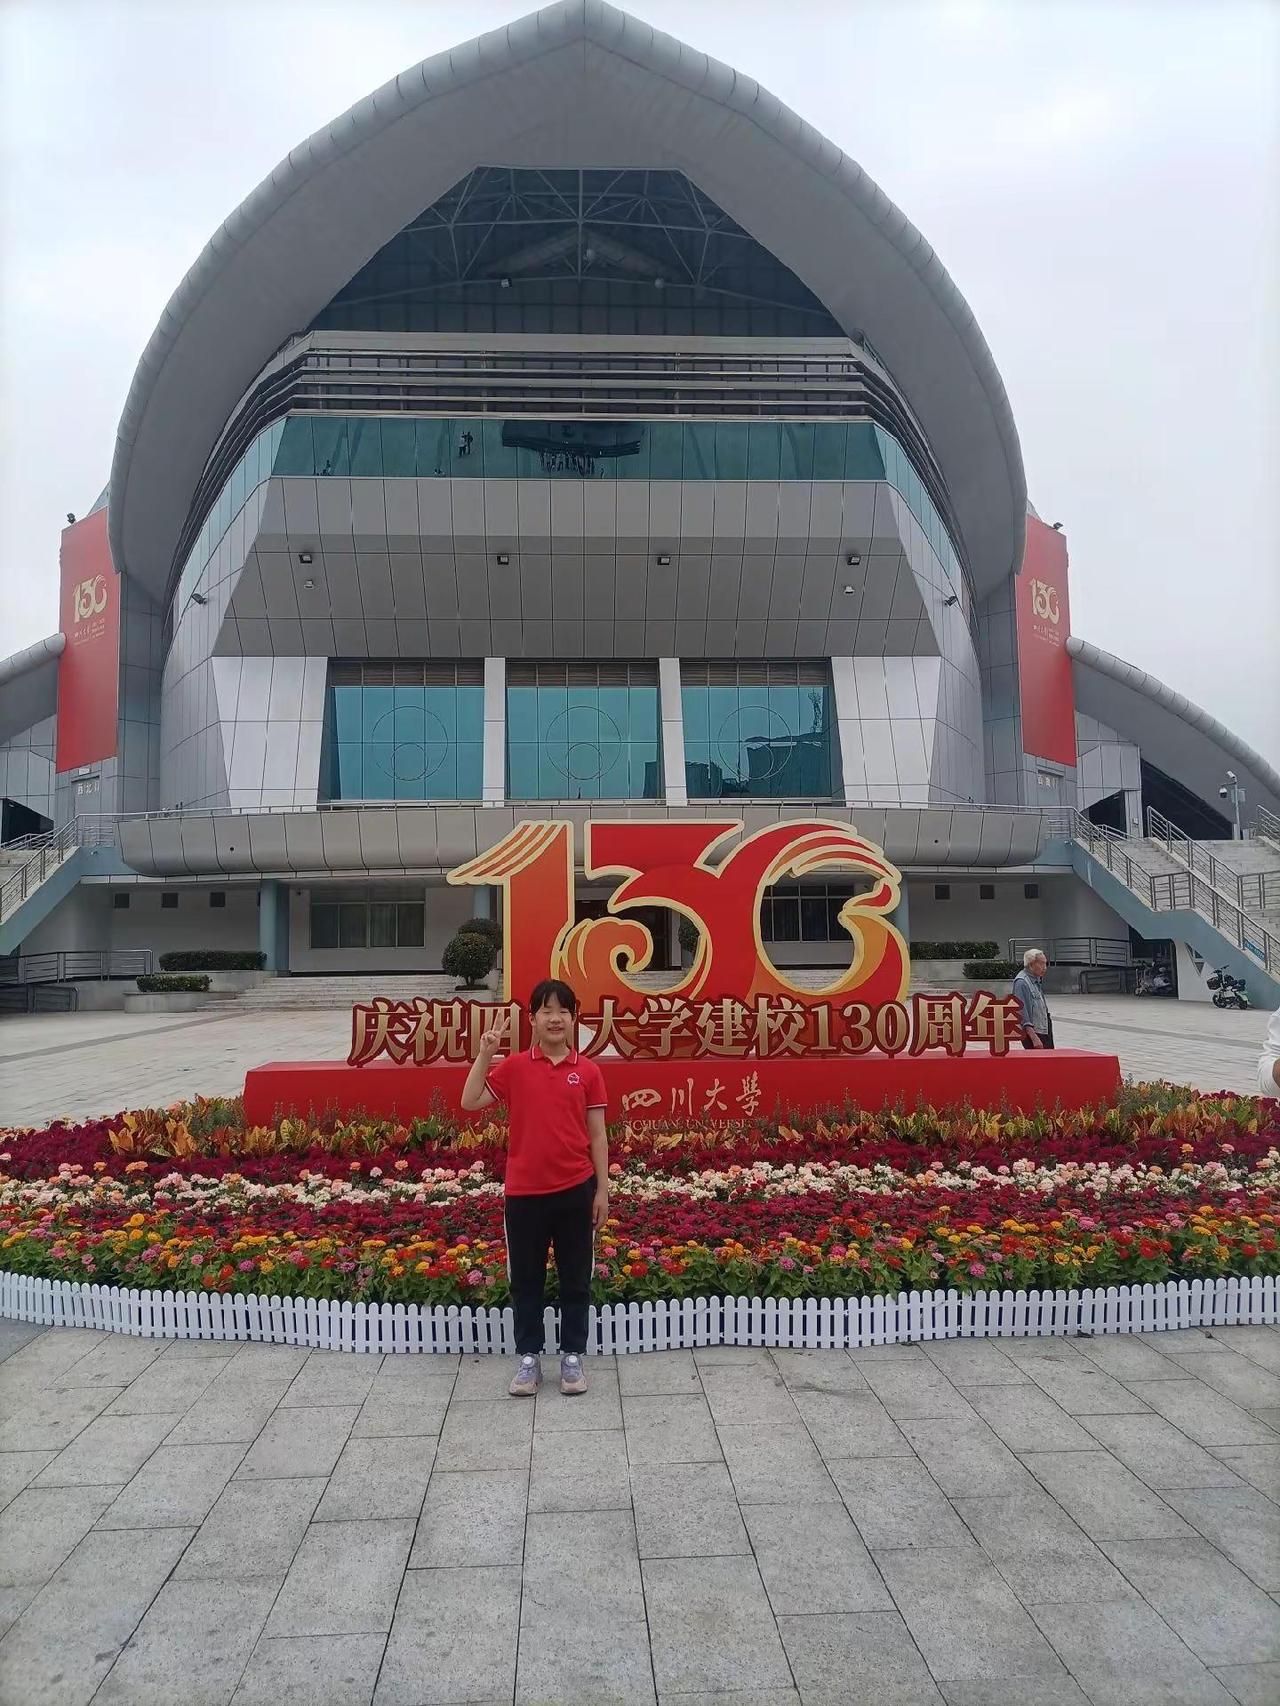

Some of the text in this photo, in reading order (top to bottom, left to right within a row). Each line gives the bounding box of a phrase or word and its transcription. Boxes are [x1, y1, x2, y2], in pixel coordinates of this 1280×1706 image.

[349, 992, 1024, 1061] 庆祝四大学建校130周年
